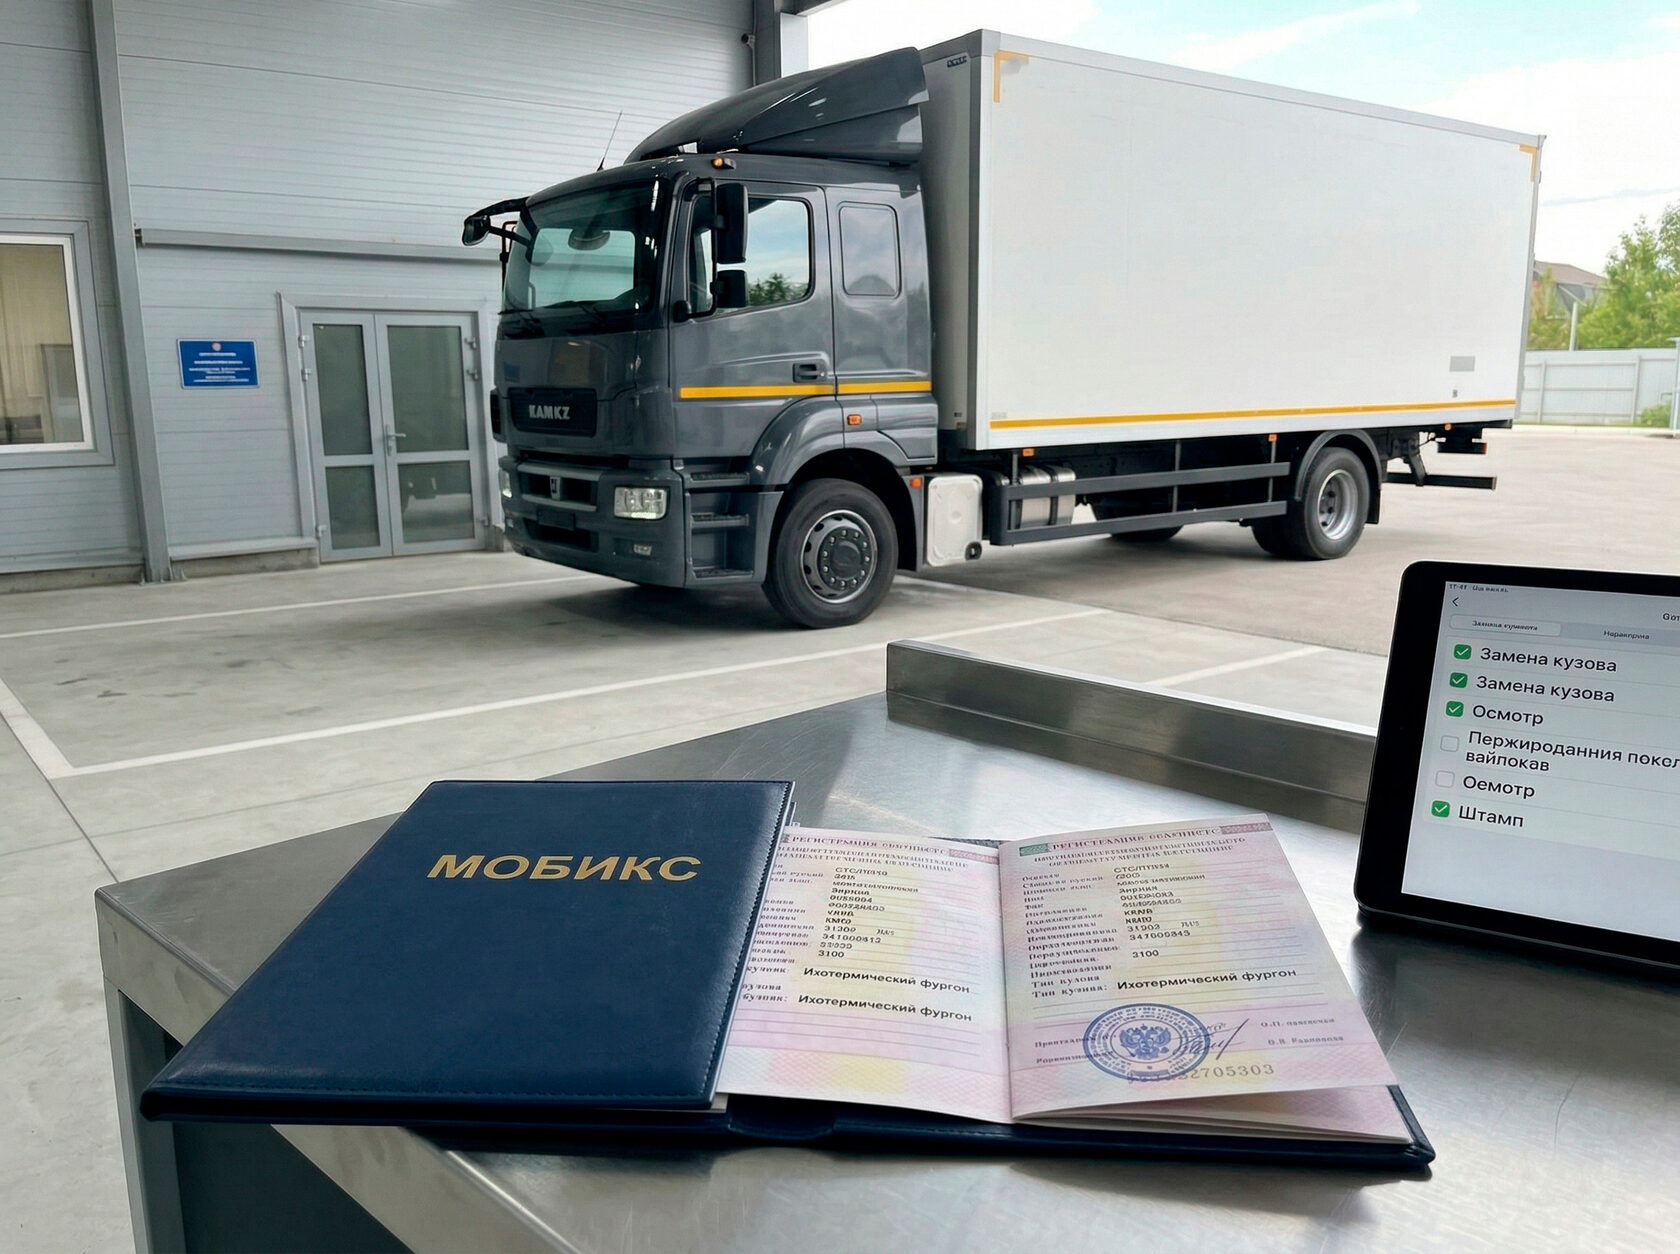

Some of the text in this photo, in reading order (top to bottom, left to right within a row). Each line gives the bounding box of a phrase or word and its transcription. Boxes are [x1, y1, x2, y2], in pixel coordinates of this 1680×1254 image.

[1480, 647, 1617, 673] Замена кузова
[1476, 675, 1615, 702] Замена кузова
[1472, 704, 1544, 725] Осмотр
[1468, 731, 1622, 761] Пержироданния
[1459, 805, 1524, 827] Штамп
[426, 854, 702, 881] МОБИКС
[1132, 949, 1159, 958] 3100
[803, 967, 916, 985] Ихотермический
[920, 978, 970, 993] фургон
[1117, 972, 1238, 990] Ихотермический
[1242, 969, 1297, 982] фургон
[798, 994, 916, 1013] Ихотермический
[920, 1006, 972, 1021] фургон
